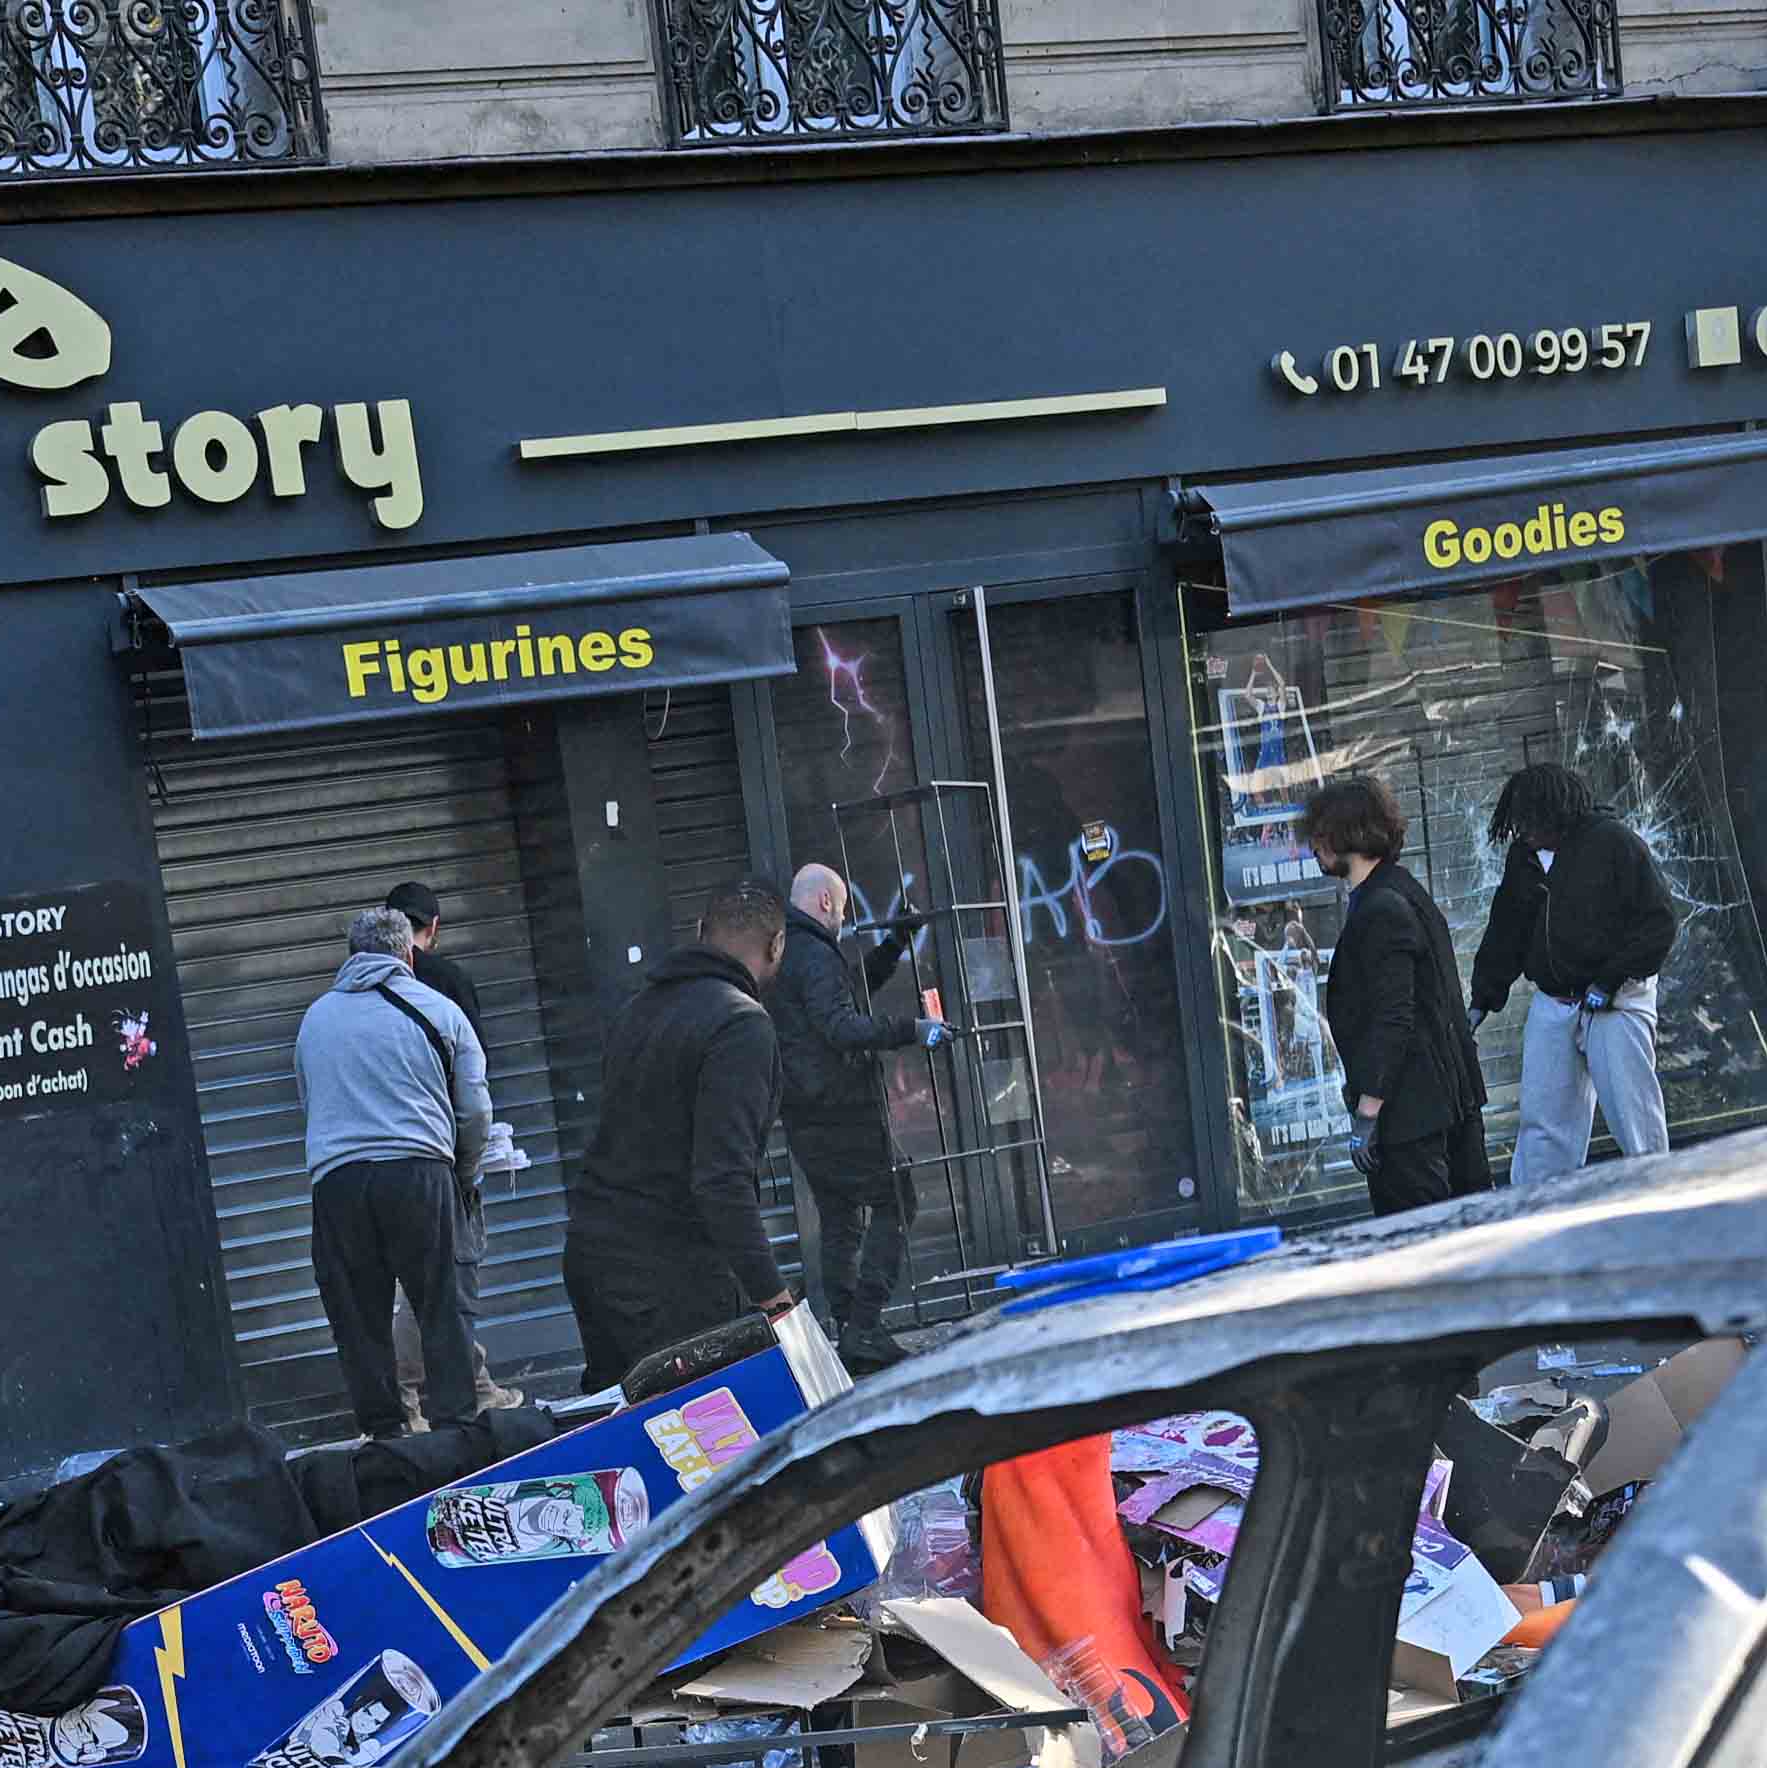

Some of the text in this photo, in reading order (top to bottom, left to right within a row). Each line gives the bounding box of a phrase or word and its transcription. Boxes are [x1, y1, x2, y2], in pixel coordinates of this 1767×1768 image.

[1330, 321, 1652, 392] 01 47 00 99 57
[31, 398, 425, 530] story
[1423, 503, 1626, 569] Goodies
[342, 624, 654, 704] Figurines
[54, 942, 153, 992] d'occasion
[29, 1013, 94, 1055] Cash
[27, 1067, 89, 1097] d'achat)
[275, 1578, 332, 1664] NARUTO
